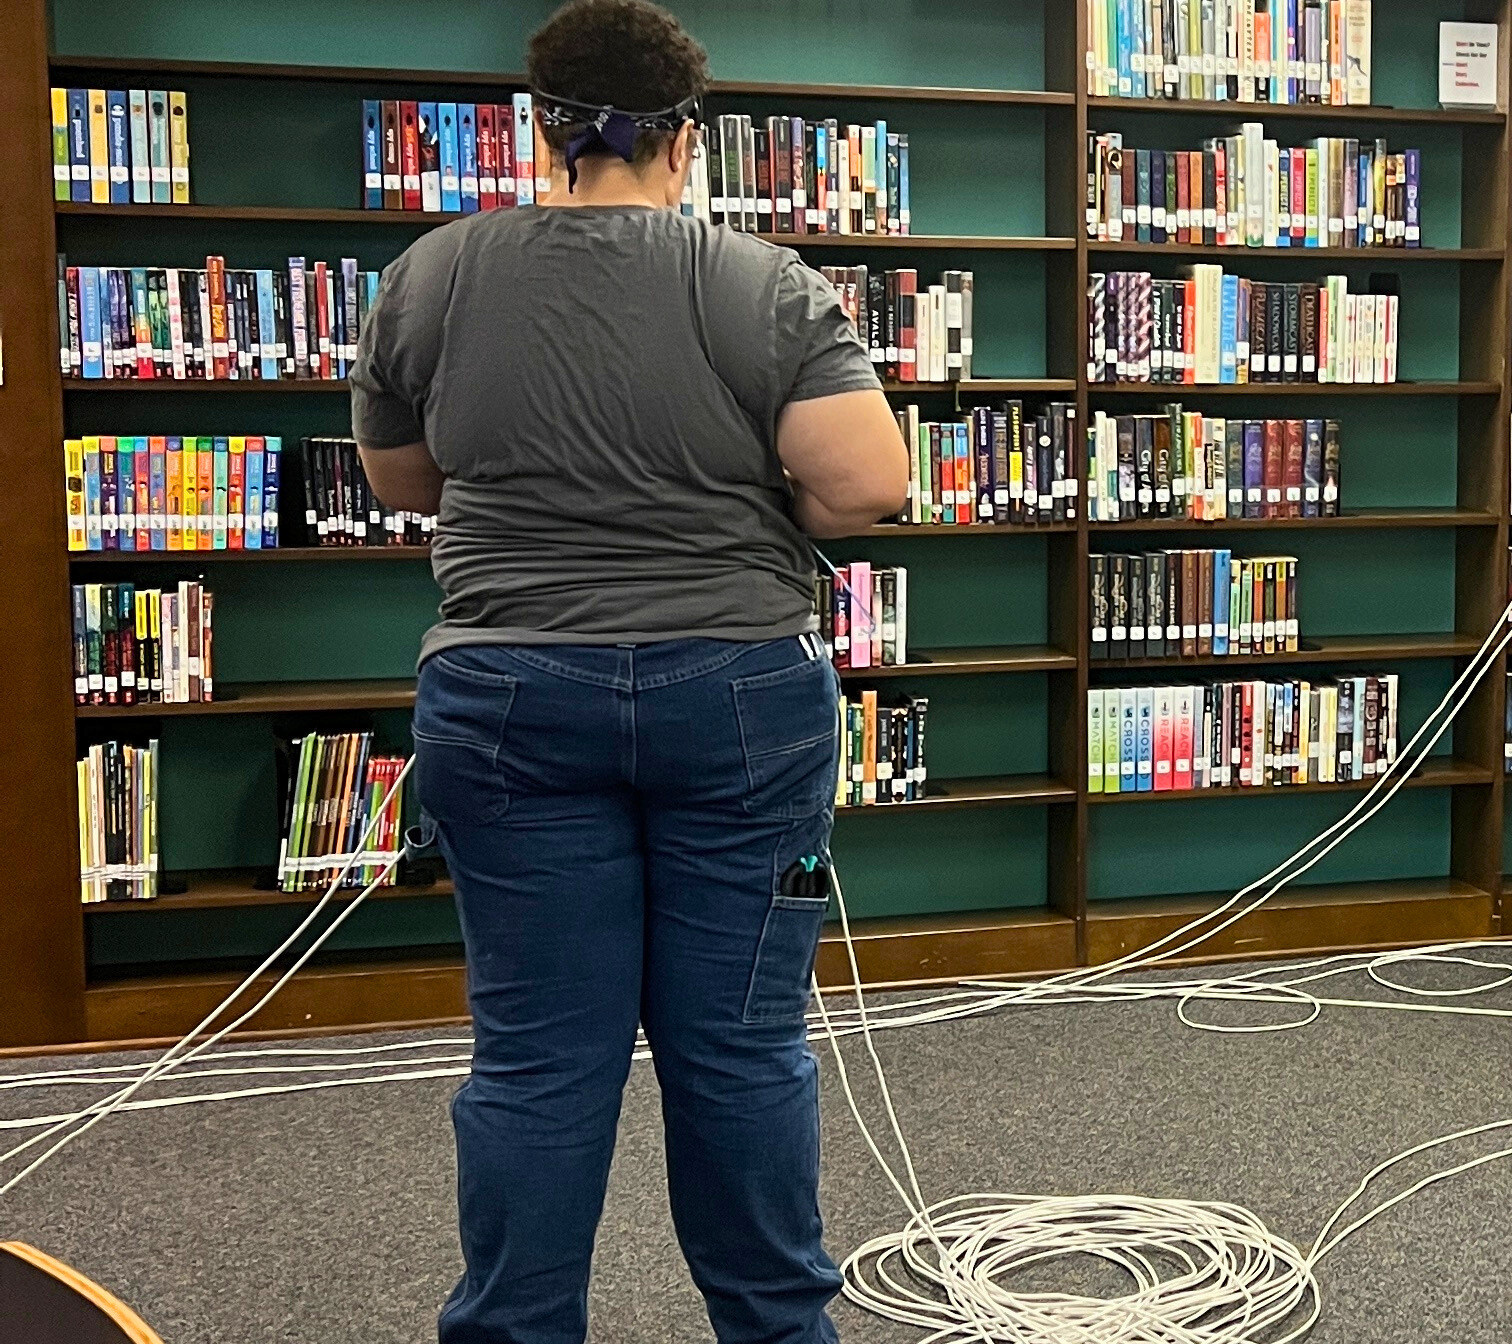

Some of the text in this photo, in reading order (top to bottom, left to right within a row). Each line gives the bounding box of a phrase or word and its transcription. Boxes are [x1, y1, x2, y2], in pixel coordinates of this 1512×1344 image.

[871, 309, 880, 348] AVALO
[1255, 292, 1266, 355] FLAMECAST
[1271, 292, 1280, 353] SHADOWCAS
[1288, 293, 1298, 354] STORMCAST
[1304, 295, 1315, 356] DEATHCAST
[1091, 721, 1100, 763] MATCH
[1108, 721, 1117, 763] MATCH
[1160, 718, 1169, 761] REACH
[1180, 718, 1189, 759] REACH
